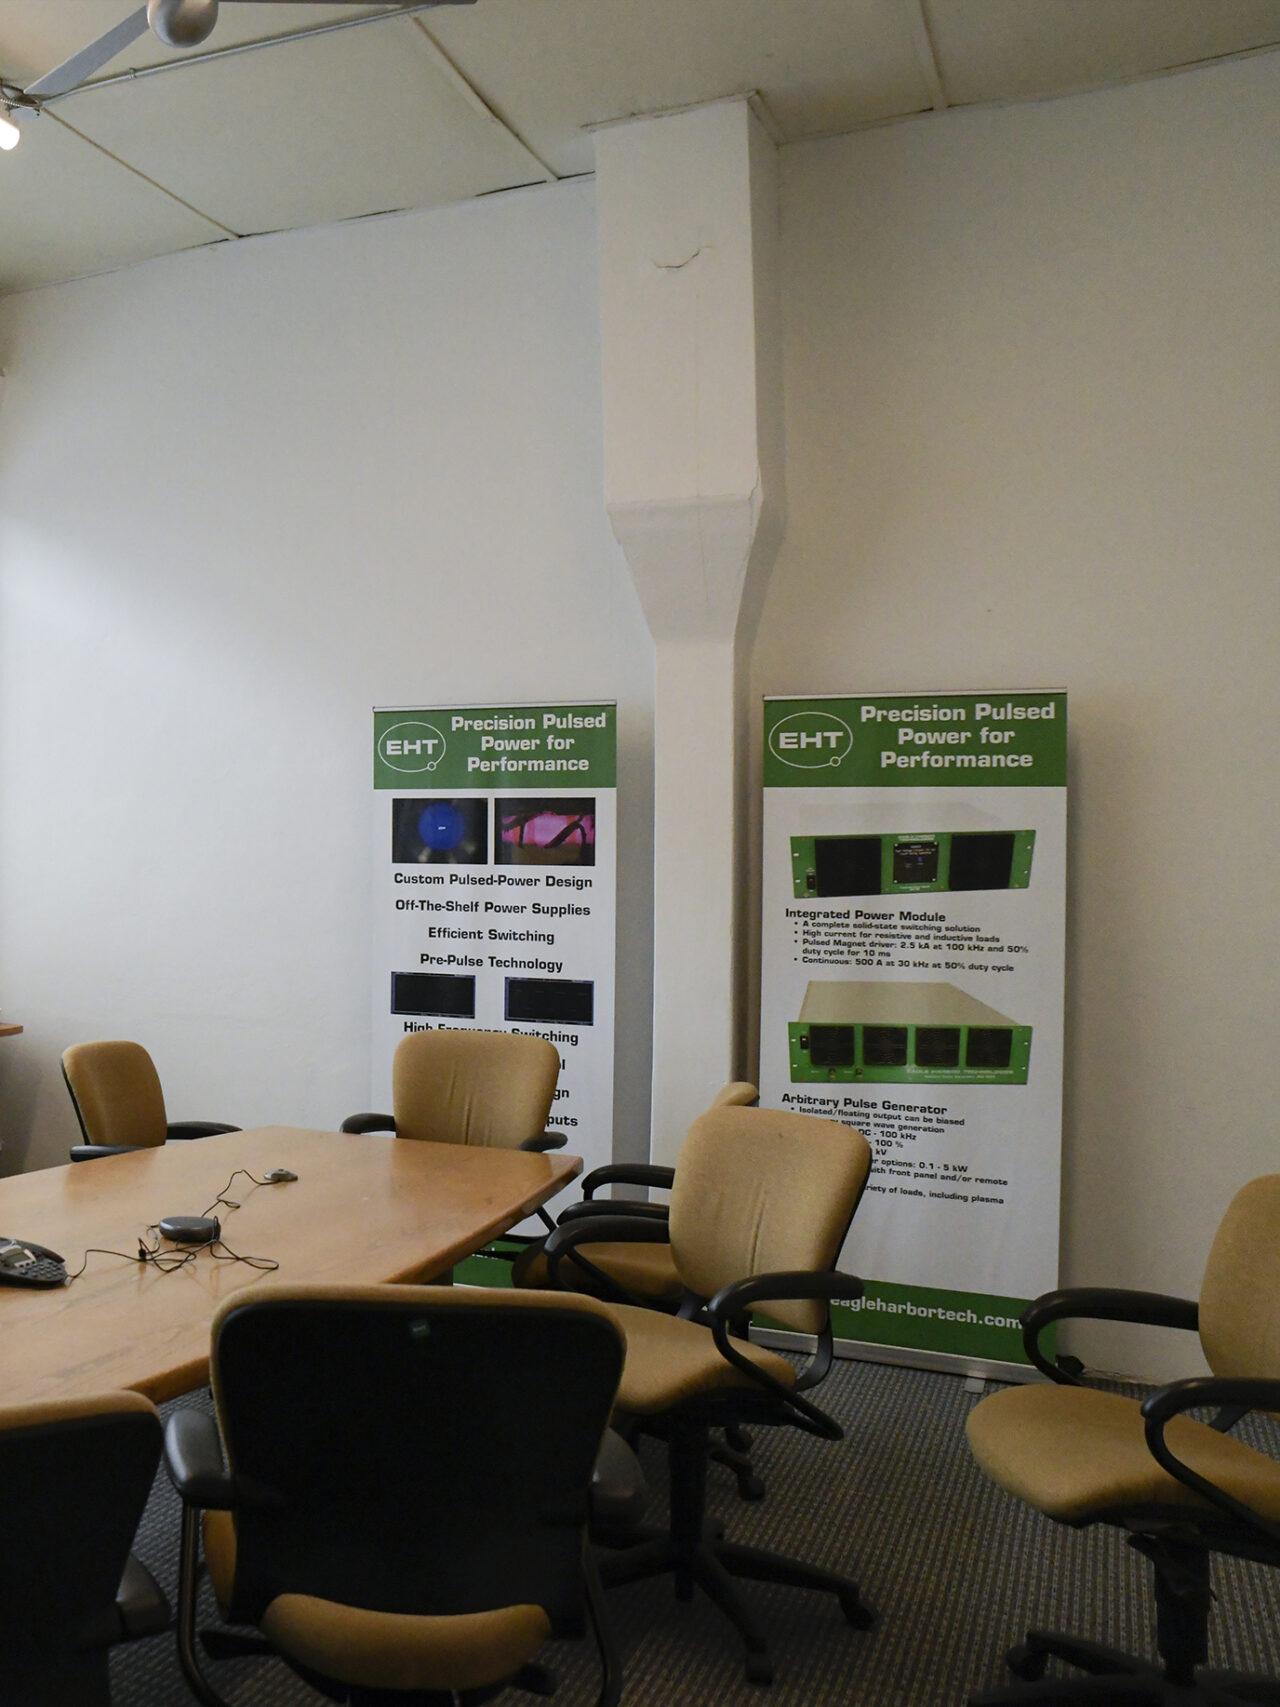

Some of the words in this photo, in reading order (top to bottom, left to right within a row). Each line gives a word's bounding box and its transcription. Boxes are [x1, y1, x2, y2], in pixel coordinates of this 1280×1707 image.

[860, 704, 966, 722] Precision
[975, 702, 1056, 720] Pulsed
[451, 715, 535, 731] Precision
[543, 712, 606, 730] Pulsed
[482, 736, 540, 751] Power
[547, 735, 575, 750] for
[779, 732, 844, 749] EHT
[898, 728, 972, 744] Power
[980, 727, 1015, 744] for
[386, 740, 438, 755] EHT
[468, 756, 589, 772] Performance
[881, 751, 1034, 768] Performance
[394, 873, 444, 884] Custom
[449, 874, 540, 887] Pulsed-Power
[546, 876, 592, 890] Design
[395, 900, 479, 912] Off-The-Shelf
[484, 902, 527, 914] Power
[532, 903, 590, 917] Supplies
[785, 908, 850, 920] Integrated
[855, 910, 894, 920] Power
[900, 911, 946, 922] Module
[428, 927, 483, 940] Efficient
[488, 929, 554, 945] Switching
[901, 924, 942, 932] switching
[833, 940, 866, 948] Magnet
[420, 954, 483, 967] Pre-Pulse
[488, 956, 563, 973] Technology
[802, 957, 852, 965] Continuous:
[968, 963, 988, 972] duty
[992, 964, 1014, 972] cycle
[782, 1093, 839, 1108] Arbitrary
[844, 1098, 877, 1109] Pulse
[882, 1101, 947, 1114] Generator
[800, 1106, 870, 1118] Isolated/floating
[873, 1112, 901, 1121] output
[936, 1117, 965, 1125] biased
[898, 1124, 944, 1133] generation
[919, 1161, 934, 1169] 0.1
[889, 1168, 911, 1176] front
[914, 1170, 937, 1179] panel
[940, 1174, 972, 1182] and/or
[975, 1177, 1008, 1186] remote
[900, 1188, 926, 1198] loads,
[929, 1190, 968, 1202] including
[971, 1193, 1004, 1204] plasma
